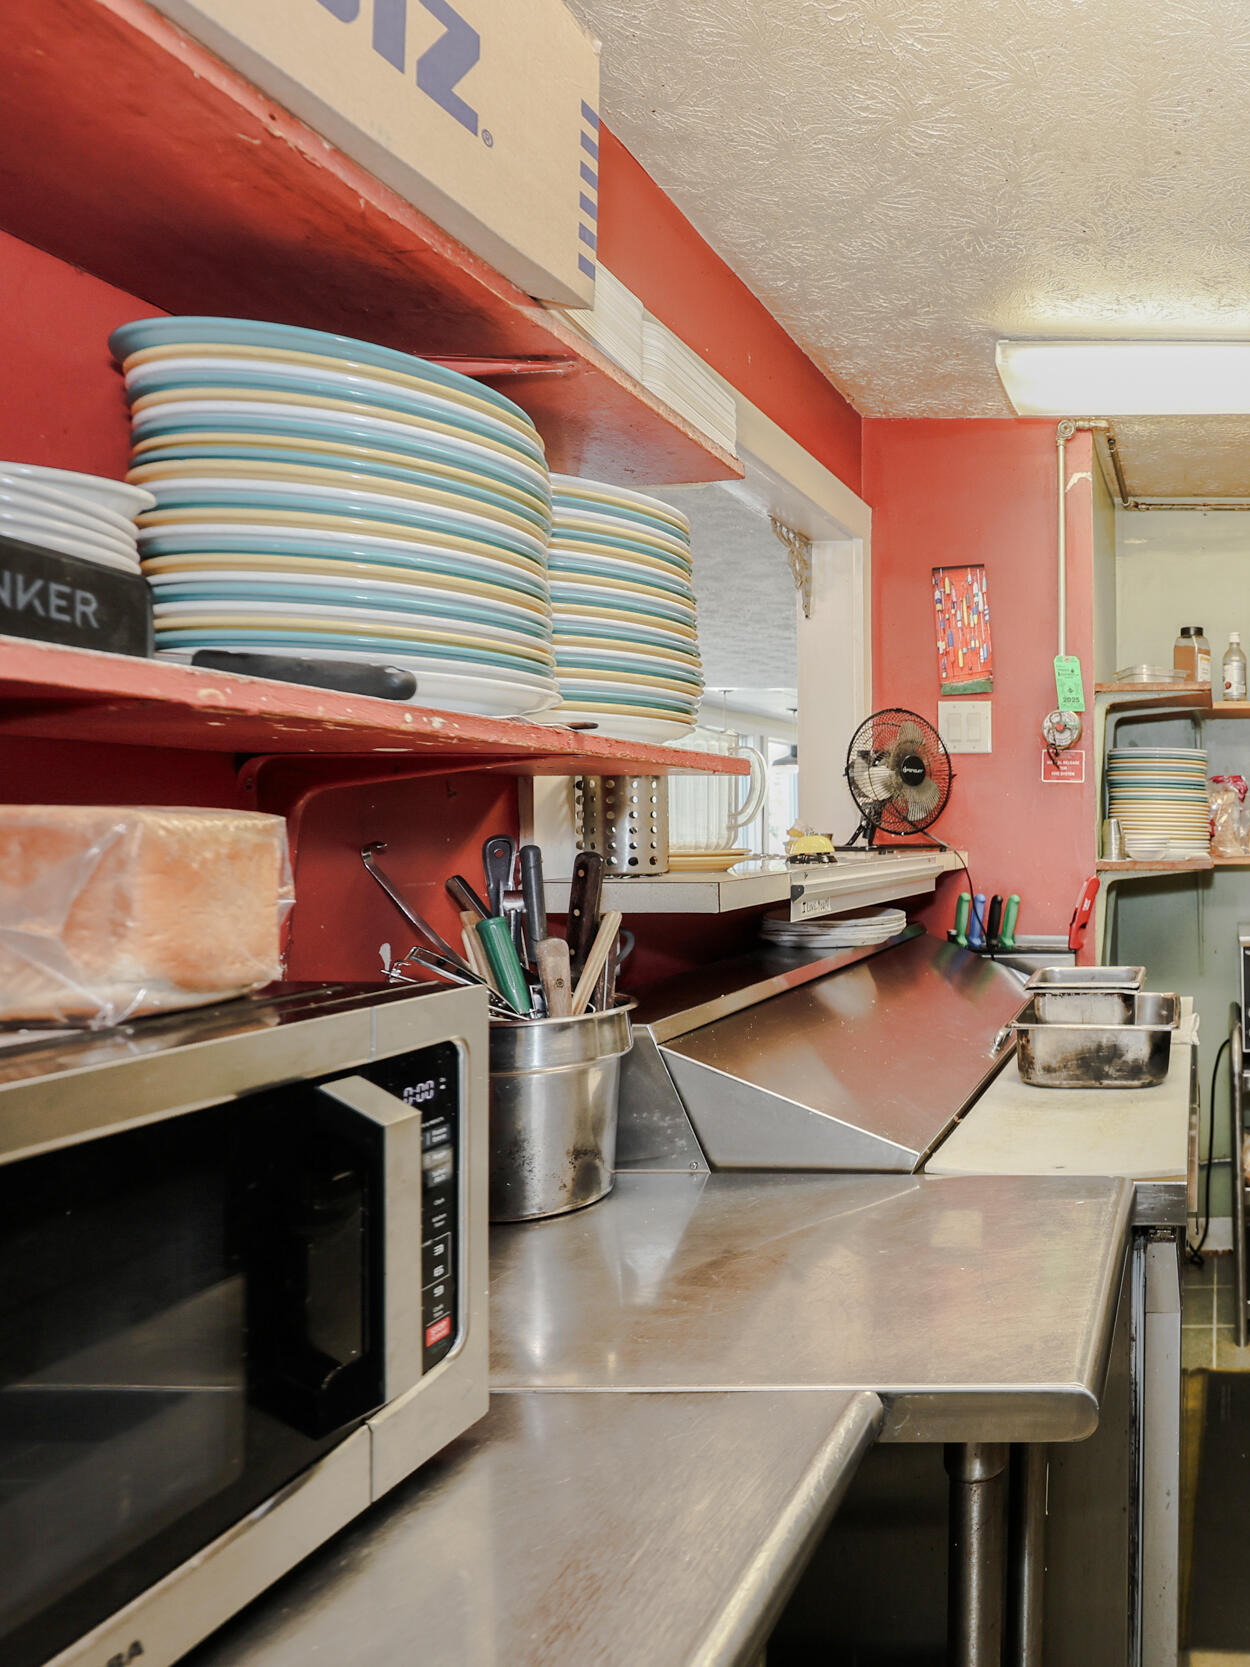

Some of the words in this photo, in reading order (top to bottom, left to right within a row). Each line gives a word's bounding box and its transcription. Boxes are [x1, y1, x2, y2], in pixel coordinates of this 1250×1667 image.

[433, 1244, 445, 1256] 3
[433, 1265, 445, 1277] 6
[433, 1285, 445, 1297] 9
